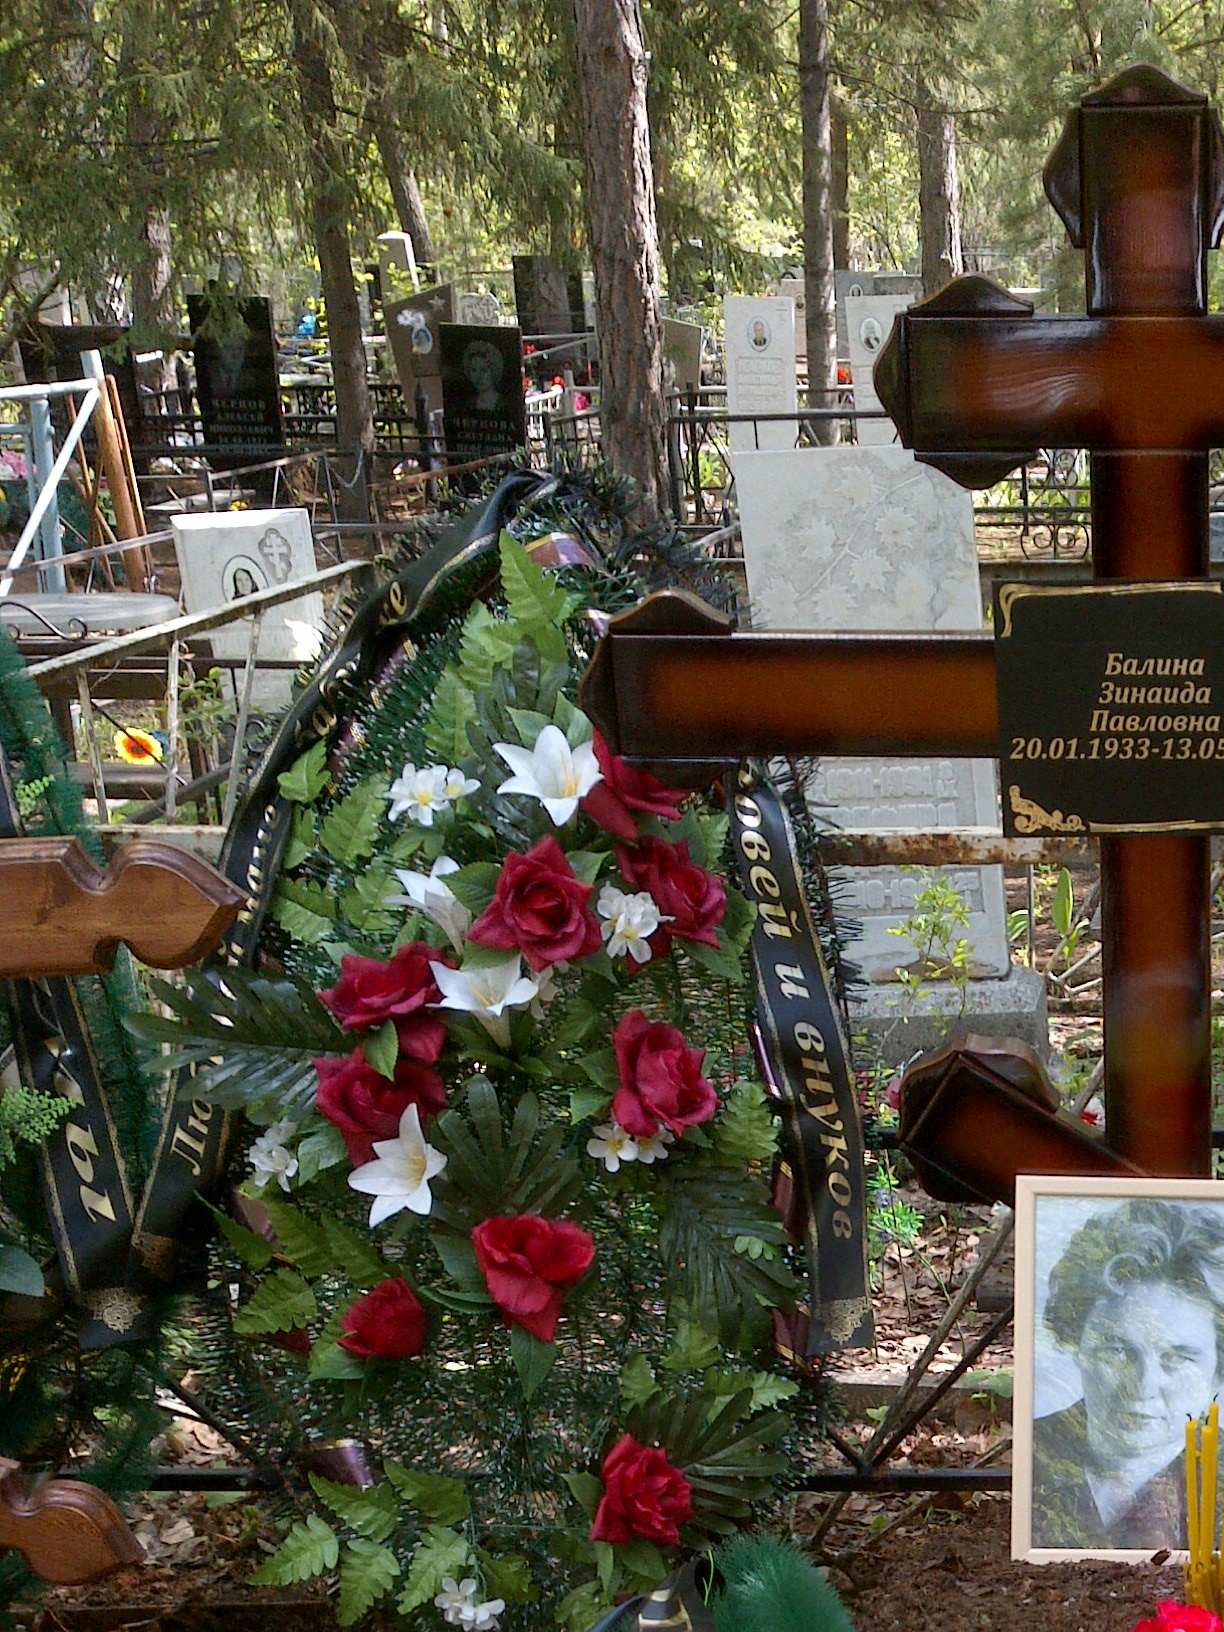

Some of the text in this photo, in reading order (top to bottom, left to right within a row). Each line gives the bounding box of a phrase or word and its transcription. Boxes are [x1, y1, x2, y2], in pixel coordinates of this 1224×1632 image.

[1104, 652, 1206, 676] Балина
[1098, 681, 1212, 705] Зинаида
[1089, 709, 1222, 732] Павловна
[777, 962, 811, 1001] и
[793, 1021, 853, 1241] внуков
